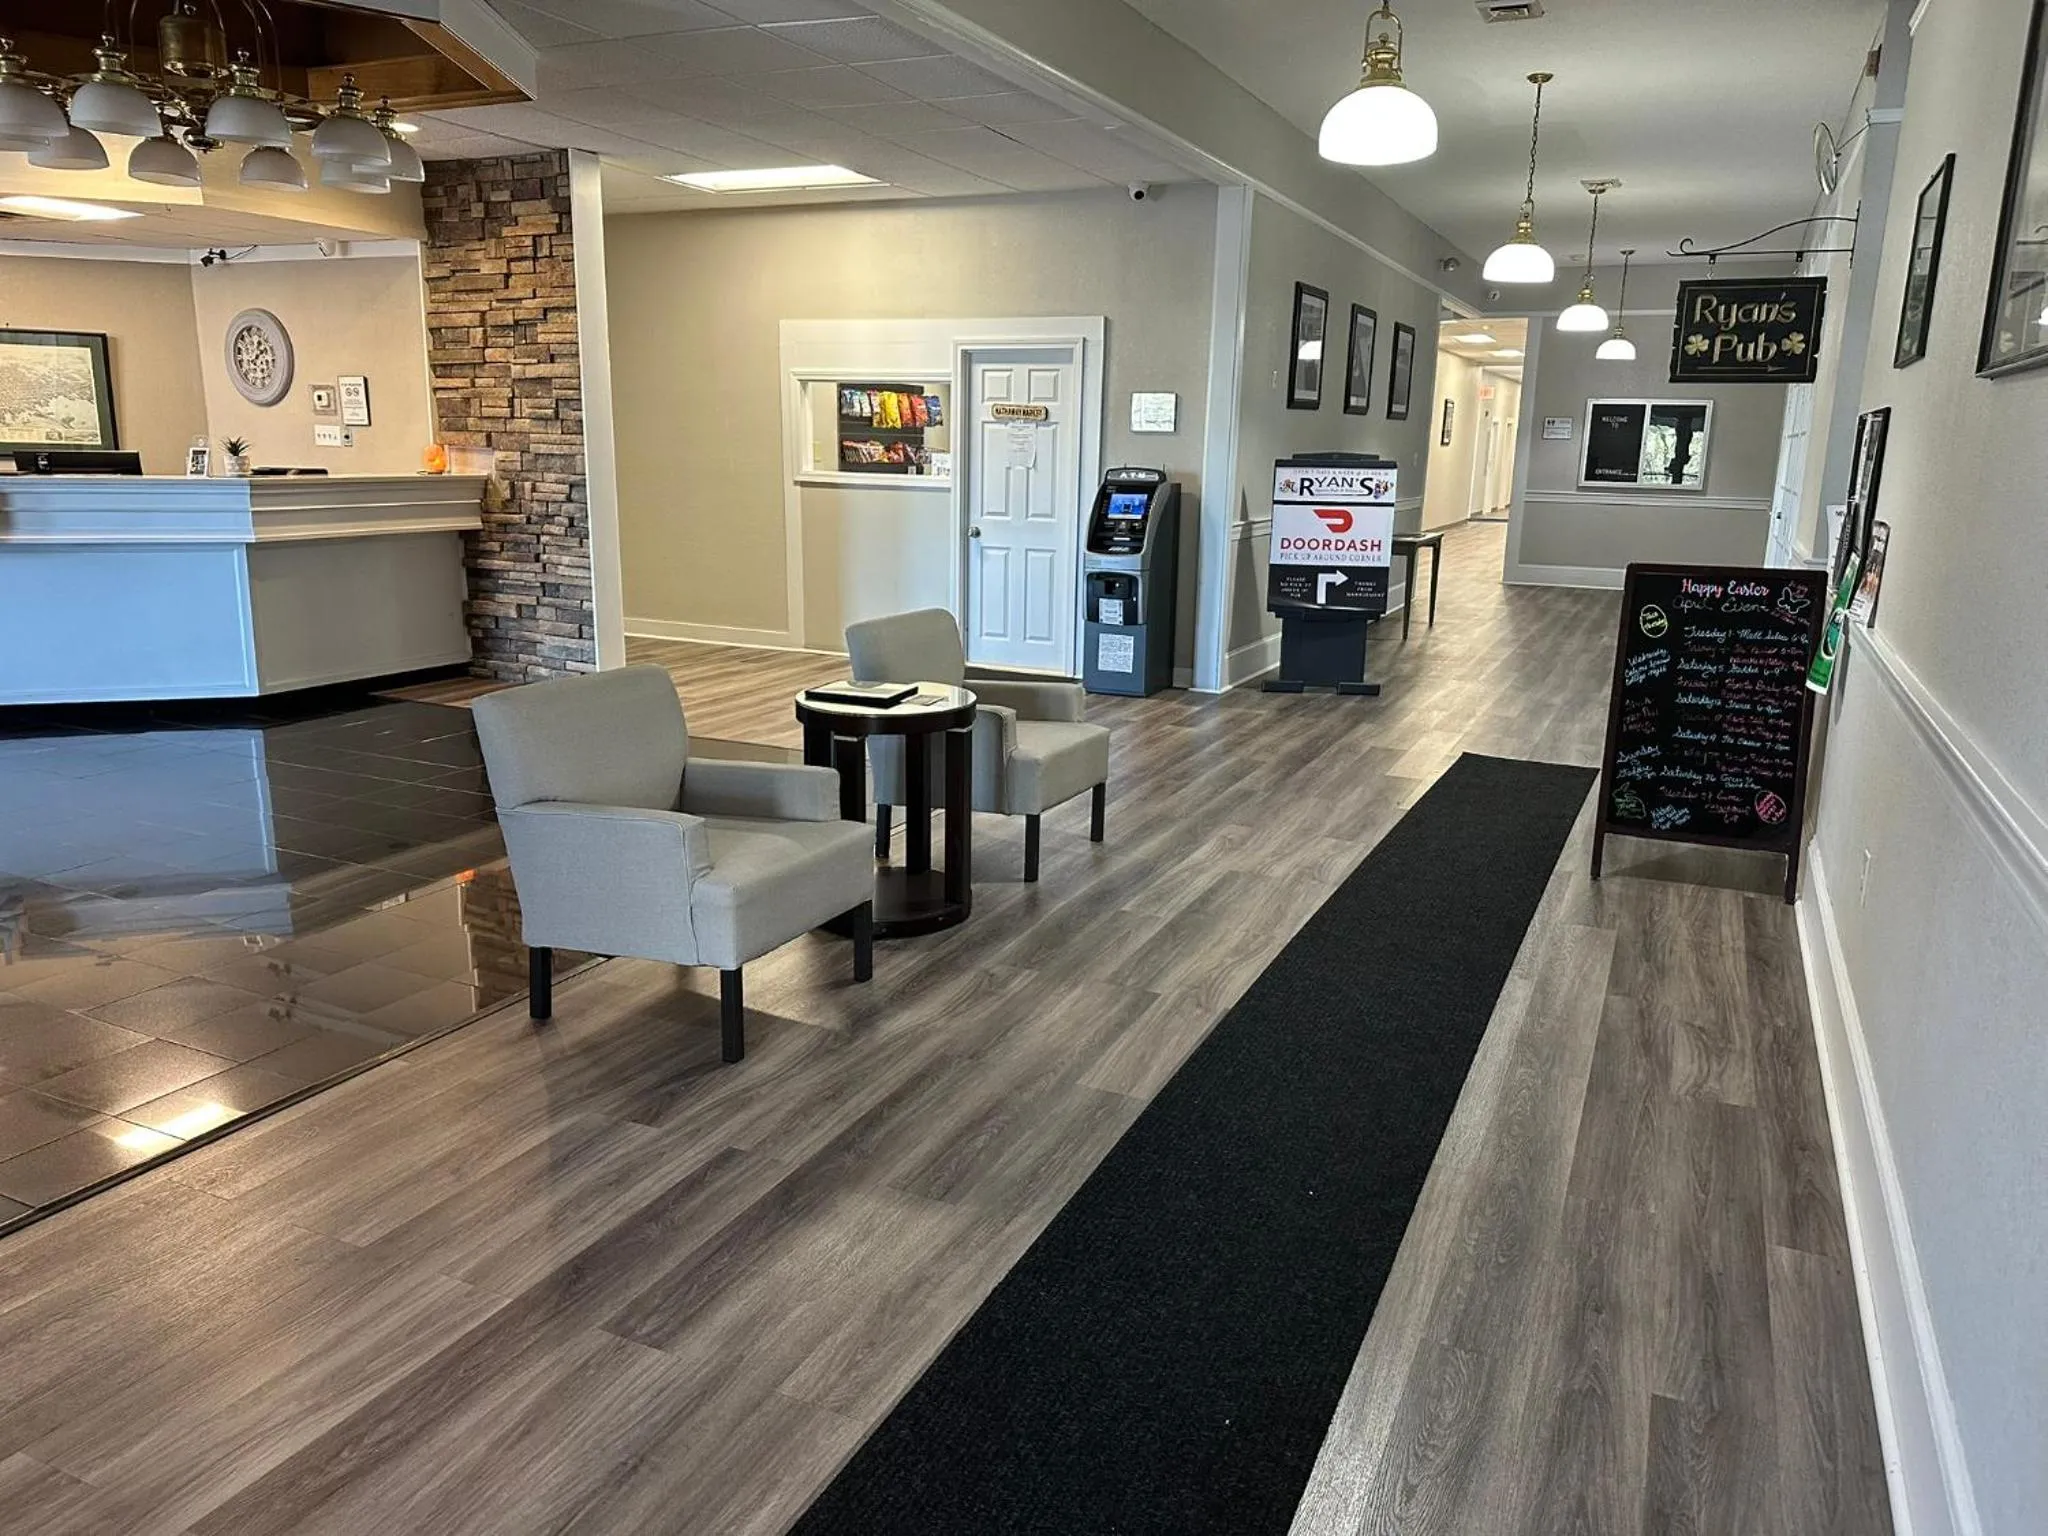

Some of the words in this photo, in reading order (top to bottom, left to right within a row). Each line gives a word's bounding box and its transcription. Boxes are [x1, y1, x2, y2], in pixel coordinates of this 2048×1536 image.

[1694, 292, 1797, 331] Ryan's
[1712, 332, 1778, 364] Pub
[1299, 477, 1374, 496] RYAN'S
[1280, 537, 1382, 553] DOORDASH
[1280, 552, 1299, 560] PICK
[1314, 553, 1347, 561] AROUND
[1349, 554, 1382, 562] CORNER
[1681, 578, 1723, 598] Happy
[1727, 580, 1770, 596] Easter
[1683, 625, 1727, 643] Tuesday
[1677, 657, 1717, 678] Saturday
[1675, 692, 1713, 709] Saturday
[1671, 725, 1709, 744] Saturday
[1616, 745, 1664, 763] Sunday
[1660, 765, 1703, 786] Saturday
